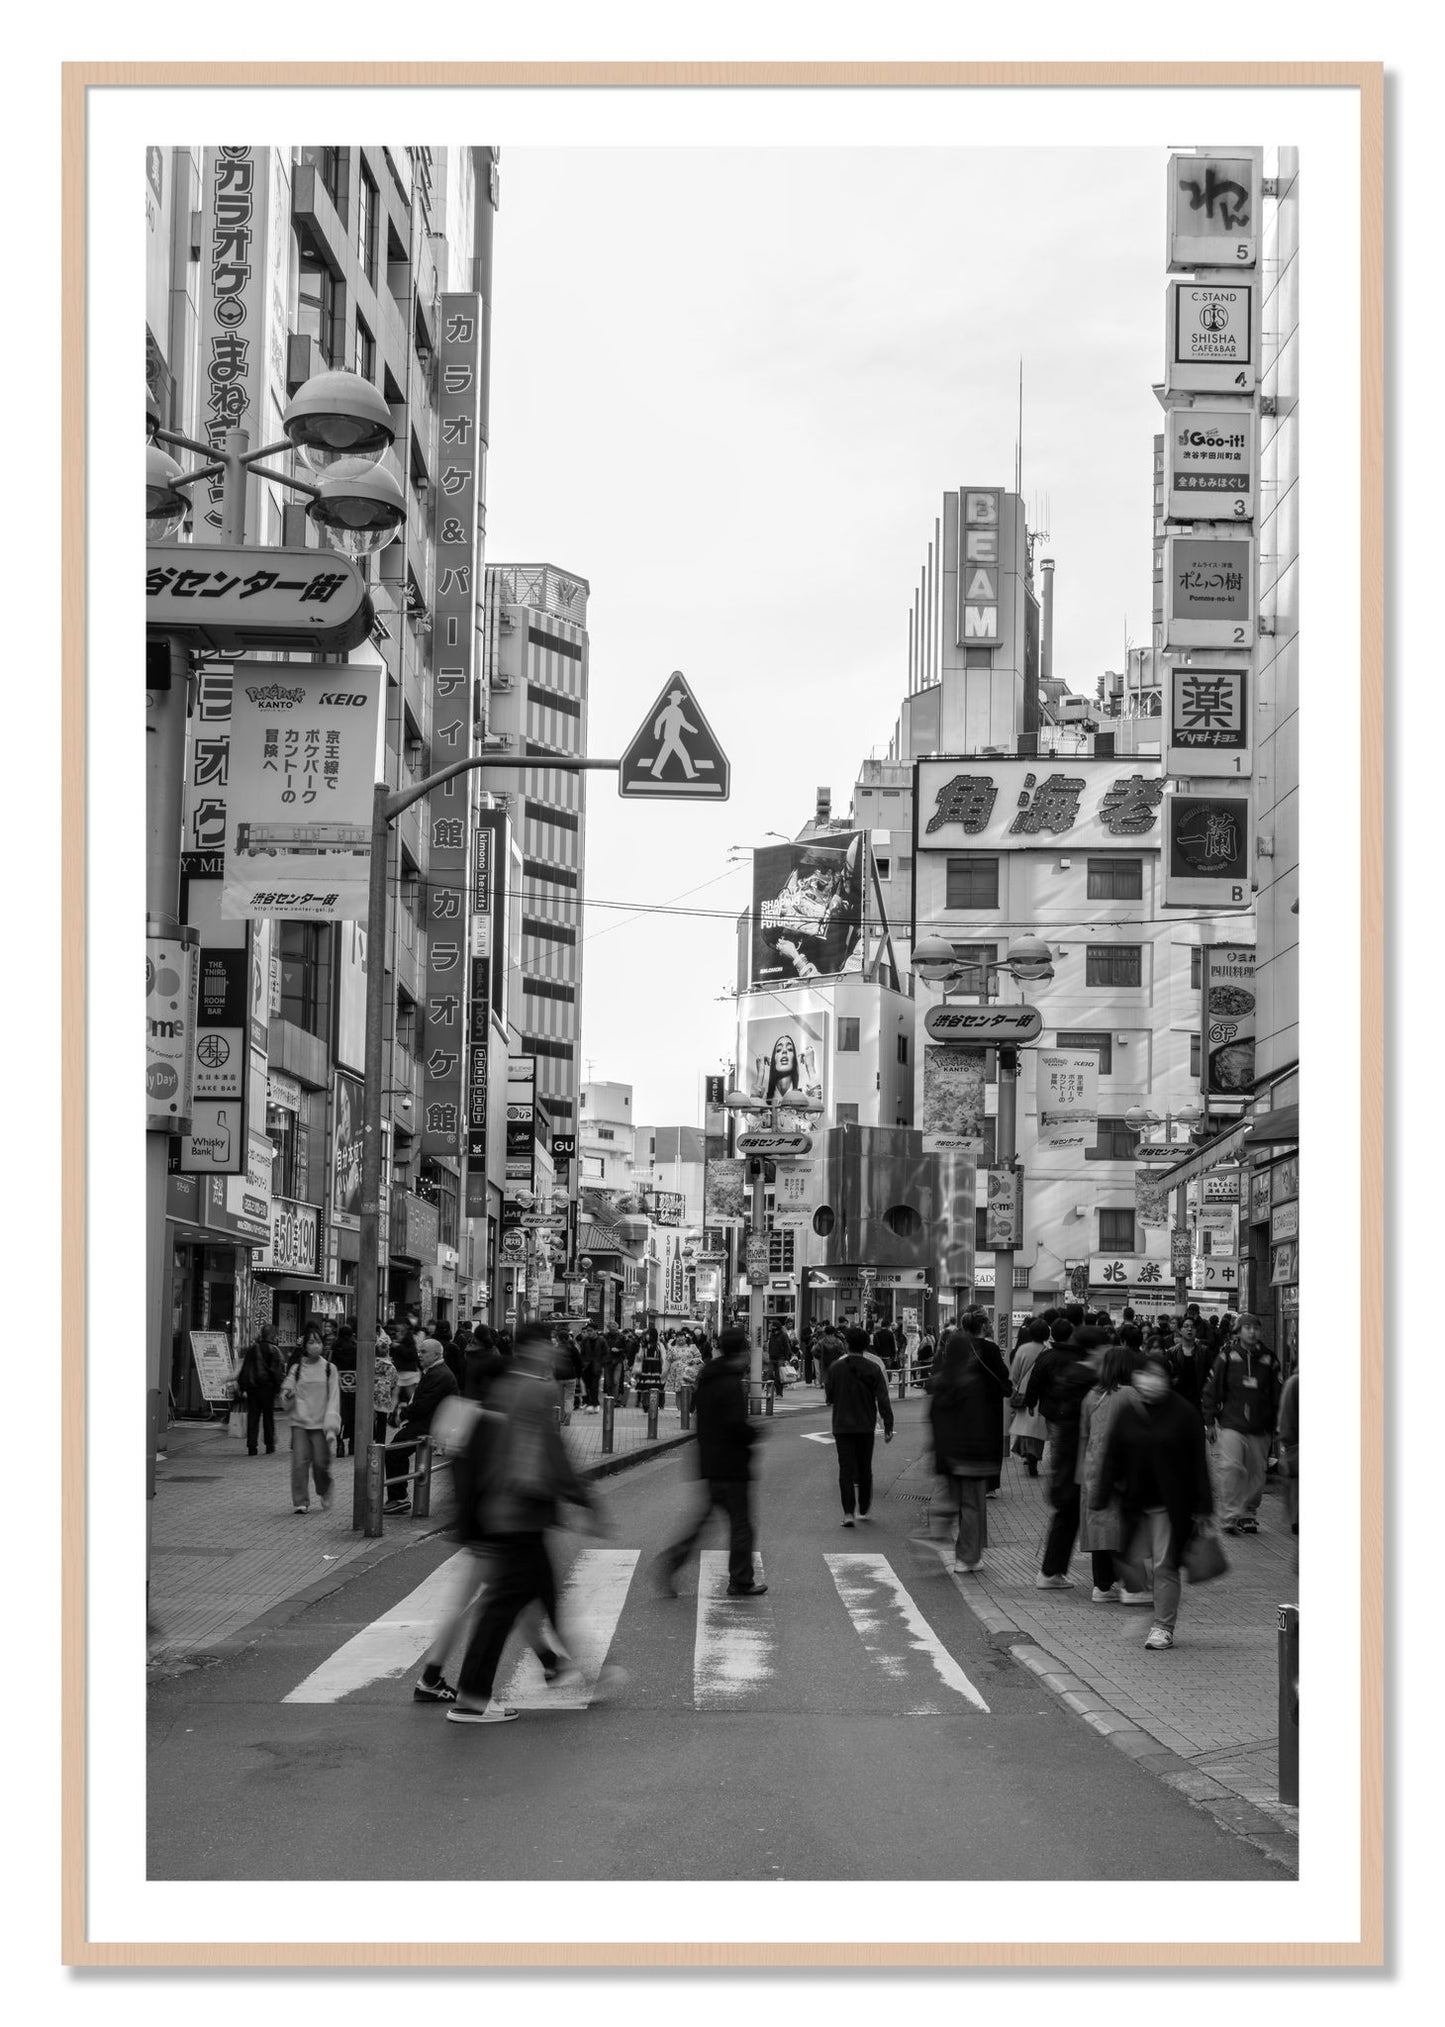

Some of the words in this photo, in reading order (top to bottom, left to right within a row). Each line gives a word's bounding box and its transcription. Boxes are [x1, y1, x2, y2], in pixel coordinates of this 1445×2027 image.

[212, 159, 255, 299] カラオケ
[1236, 244, 1249, 260] 5
[1191, 292, 1237, 302] C.STAND
[1191, 333, 1237, 344] SHISHA
[1191, 344, 1236, 353] CAFE&BAR
[1234, 371, 1247, 387] 4
[1190, 431, 1245, 448] Goo-it!
[1183, 451, 1242, 461] 渋谷宇田川町店
[1178, 476, 1246, 489] 全身もみほぐし
[1233, 499, 1245, 516] 3
[966, 493, 998, 637] BEAM
[1179, 570, 1244, 591] ポムの樹
[1233, 627, 1245, 643] 2
[258, 701, 293, 709] KANTO
[319, 693, 368, 707] KEIO
[1182, 676, 1233, 728] 薬
[263, 729, 279, 772] 冒険へ
[281, 729, 299, 804] カントーの
[302, 729, 320, 804] ポケパーク
[323, 730, 341, 790] 京王線で
[1232, 757, 1241, 772] 1
[925, 773, 1166, 835] 角海老
[478, 833, 488, 869] kimono
[249, 892, 340, 906] 渋谷センター街
[1231, 885, 1244, 902] B
[204, 968, 227, 976] THIRD
[932, 1013, 1037, 1029] 渋谷センター街
[1209, 1023, 1239, 1044] 6F
[156, 1072, 177, 1087] Day!
[192, 1137, 226, 1149] Whisky
[554, 1141, 574, 1152] GU
[740, 1137, 803, 1148] 渋谷センター街
[191, 1146, 212, 1156] Bank
[1103, 1261, 1163, 1283] 兆楽
